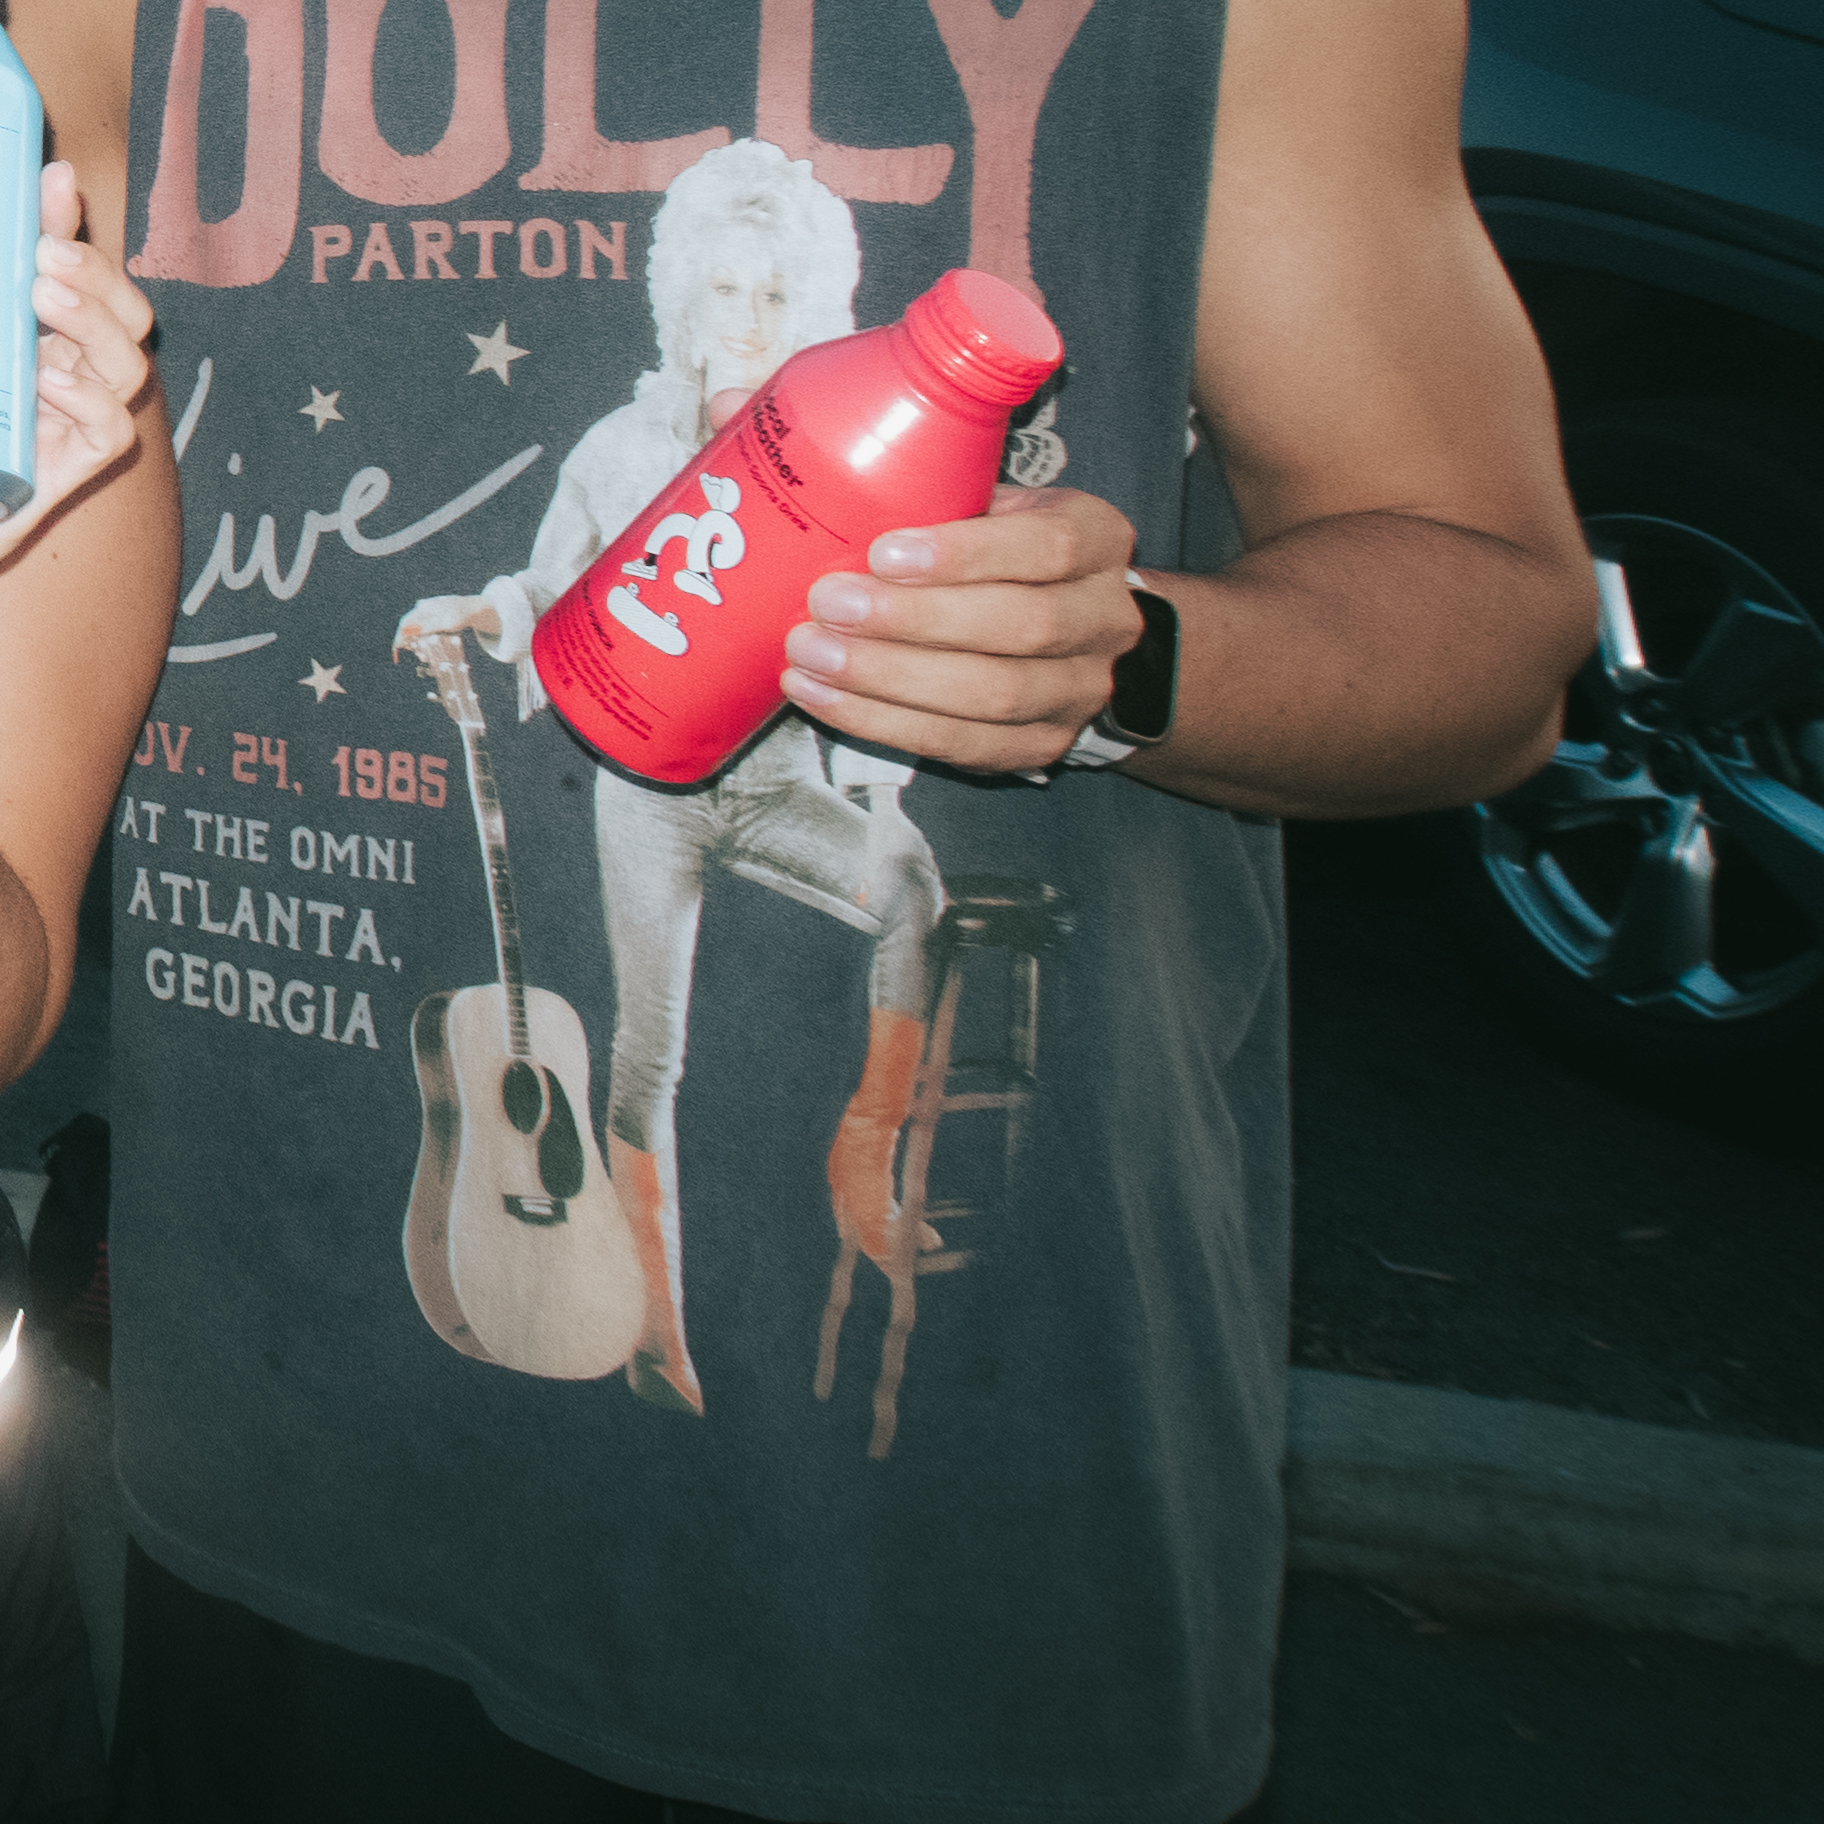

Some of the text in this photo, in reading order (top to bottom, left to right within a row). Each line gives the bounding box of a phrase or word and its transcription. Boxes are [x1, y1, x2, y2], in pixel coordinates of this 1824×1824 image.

[308, 219, 630, 284] PARTON
[134, 720, 449, 809] OV. 24, 1985
[120, 795, 416, 885] AT THE OMNI
[127, 866, 402, 973] ATLANTA,
[145, 946, 380, 1050] GEORGIA
